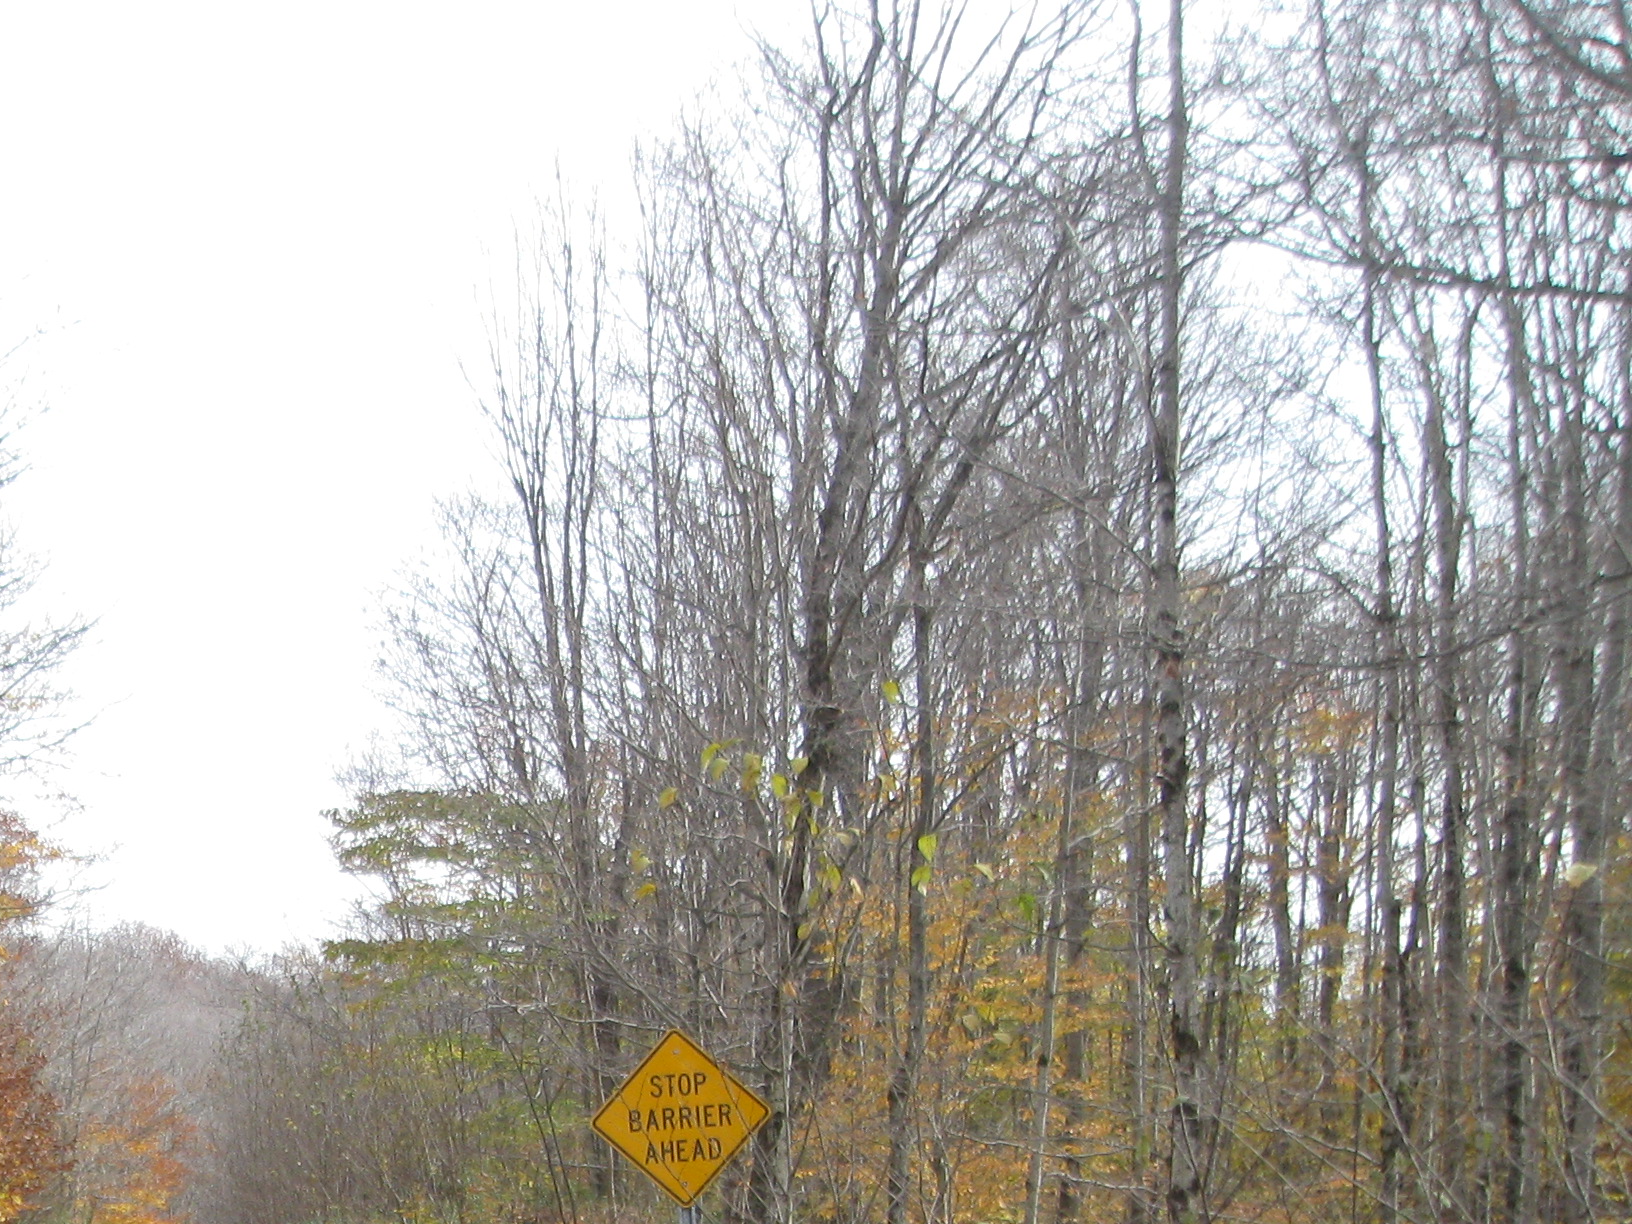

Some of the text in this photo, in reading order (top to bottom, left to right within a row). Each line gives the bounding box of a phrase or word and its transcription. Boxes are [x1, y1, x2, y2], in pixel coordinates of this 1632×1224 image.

[650, 1073, 706, 1098] STOP
[628, 1104, 732, 1133] BARRIER
[645, 1138, 722, 1165] AHEAD
